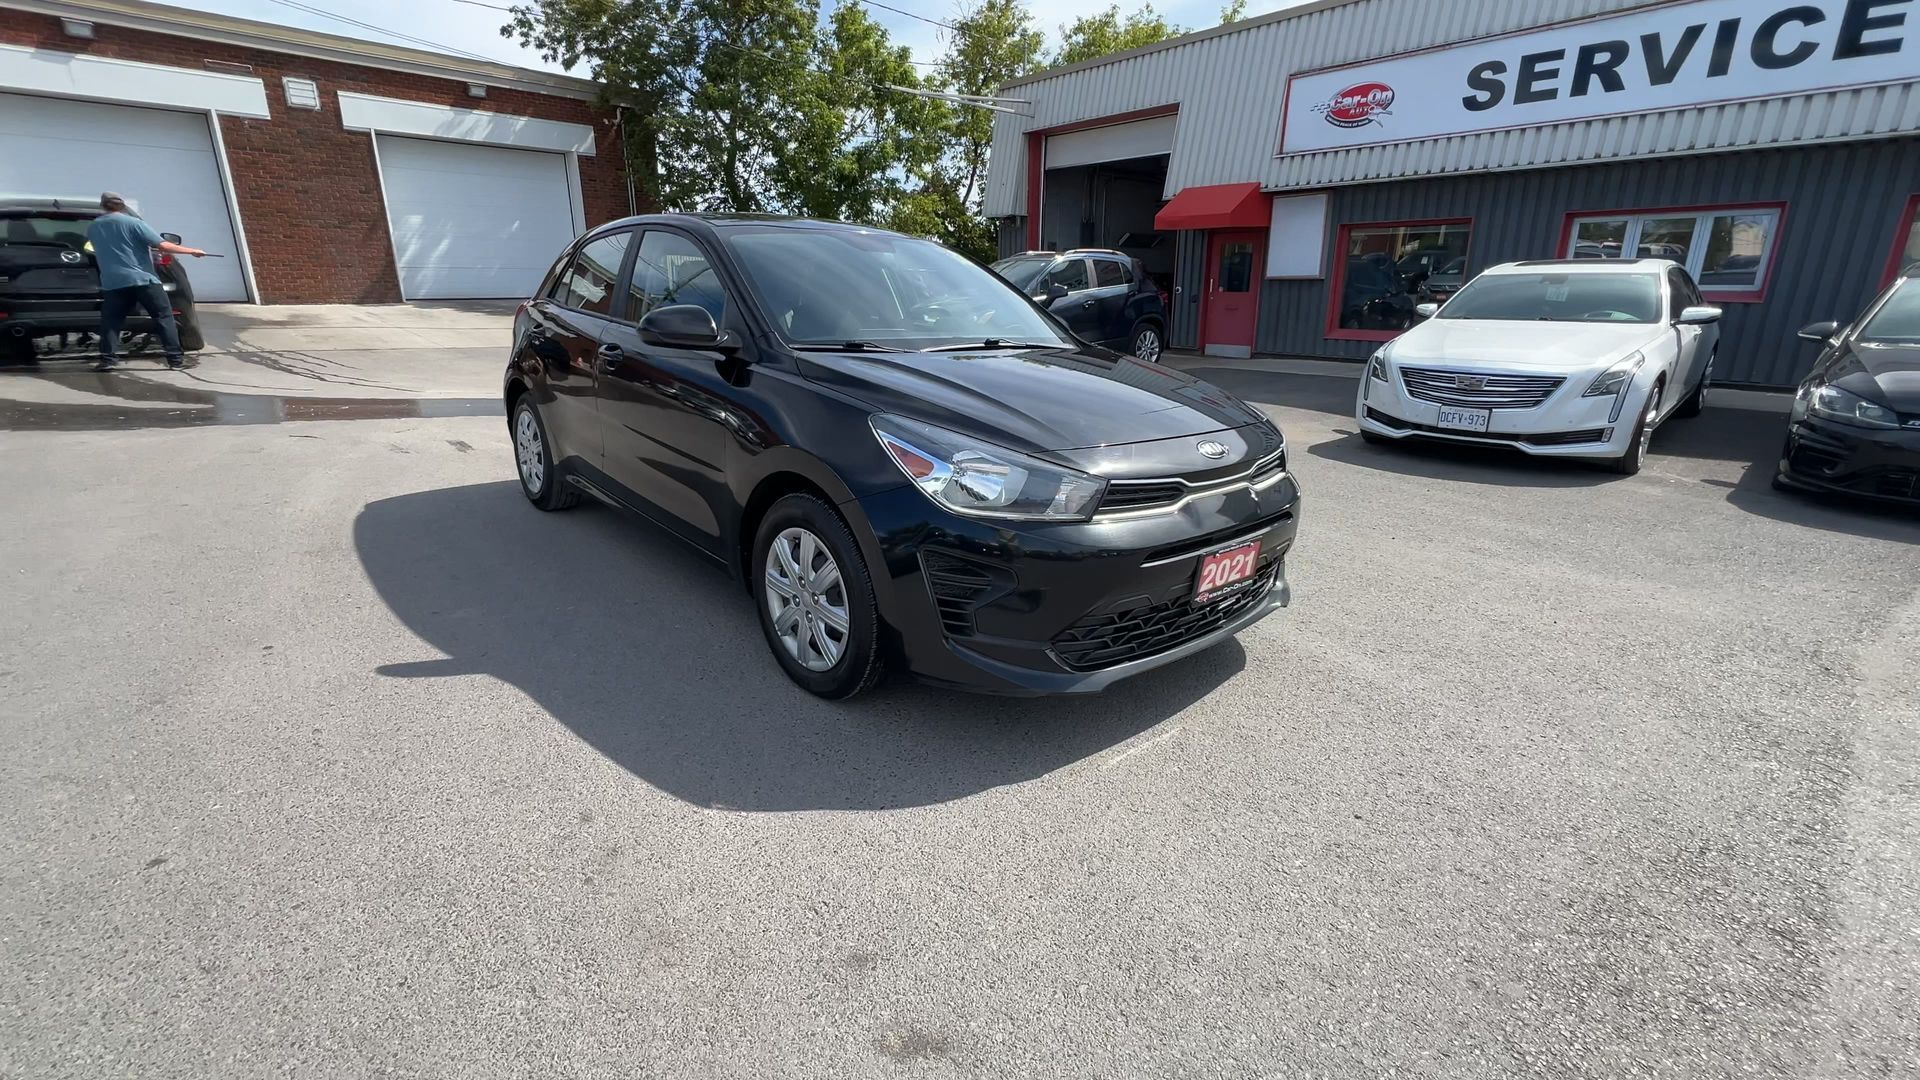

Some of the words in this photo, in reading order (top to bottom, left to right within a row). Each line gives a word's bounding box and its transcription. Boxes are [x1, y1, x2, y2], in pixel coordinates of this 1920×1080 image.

[1462, 0, 1914, 112] SERVICE
[1330, 89, 1393, 111] Car-On
[1199, 551, 1256, 593] 2021
